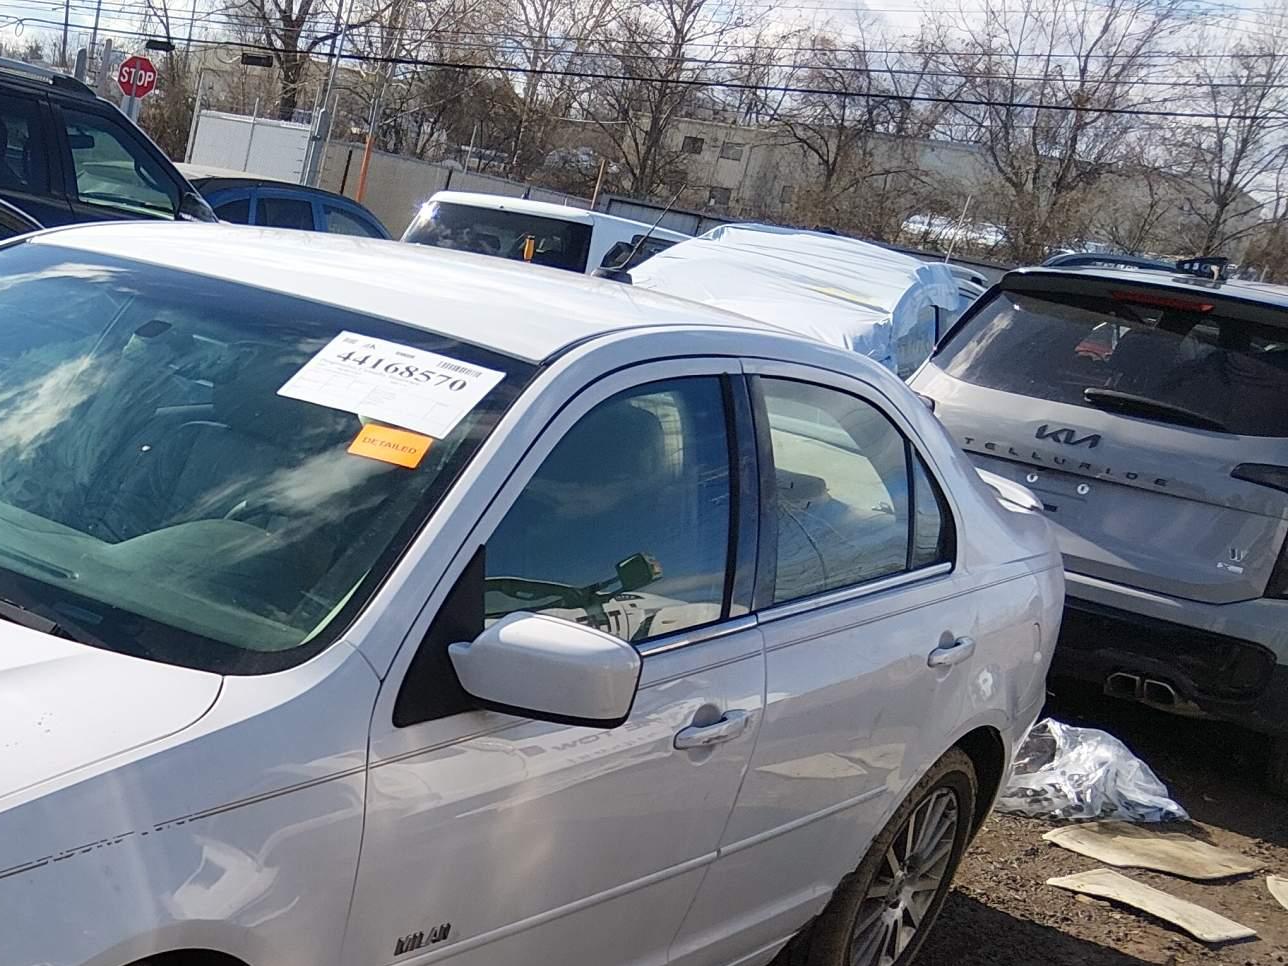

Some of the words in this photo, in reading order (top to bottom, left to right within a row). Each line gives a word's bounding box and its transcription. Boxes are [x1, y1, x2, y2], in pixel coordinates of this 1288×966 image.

[120, 67, 154, 87] STOP
[337, 351, 466, 392] 44168570
[361, 436, 417, 456] DETAILED
[964, 437, 1169, 487] TELLURIDE
[393, 921, 451, 957] MILAN
